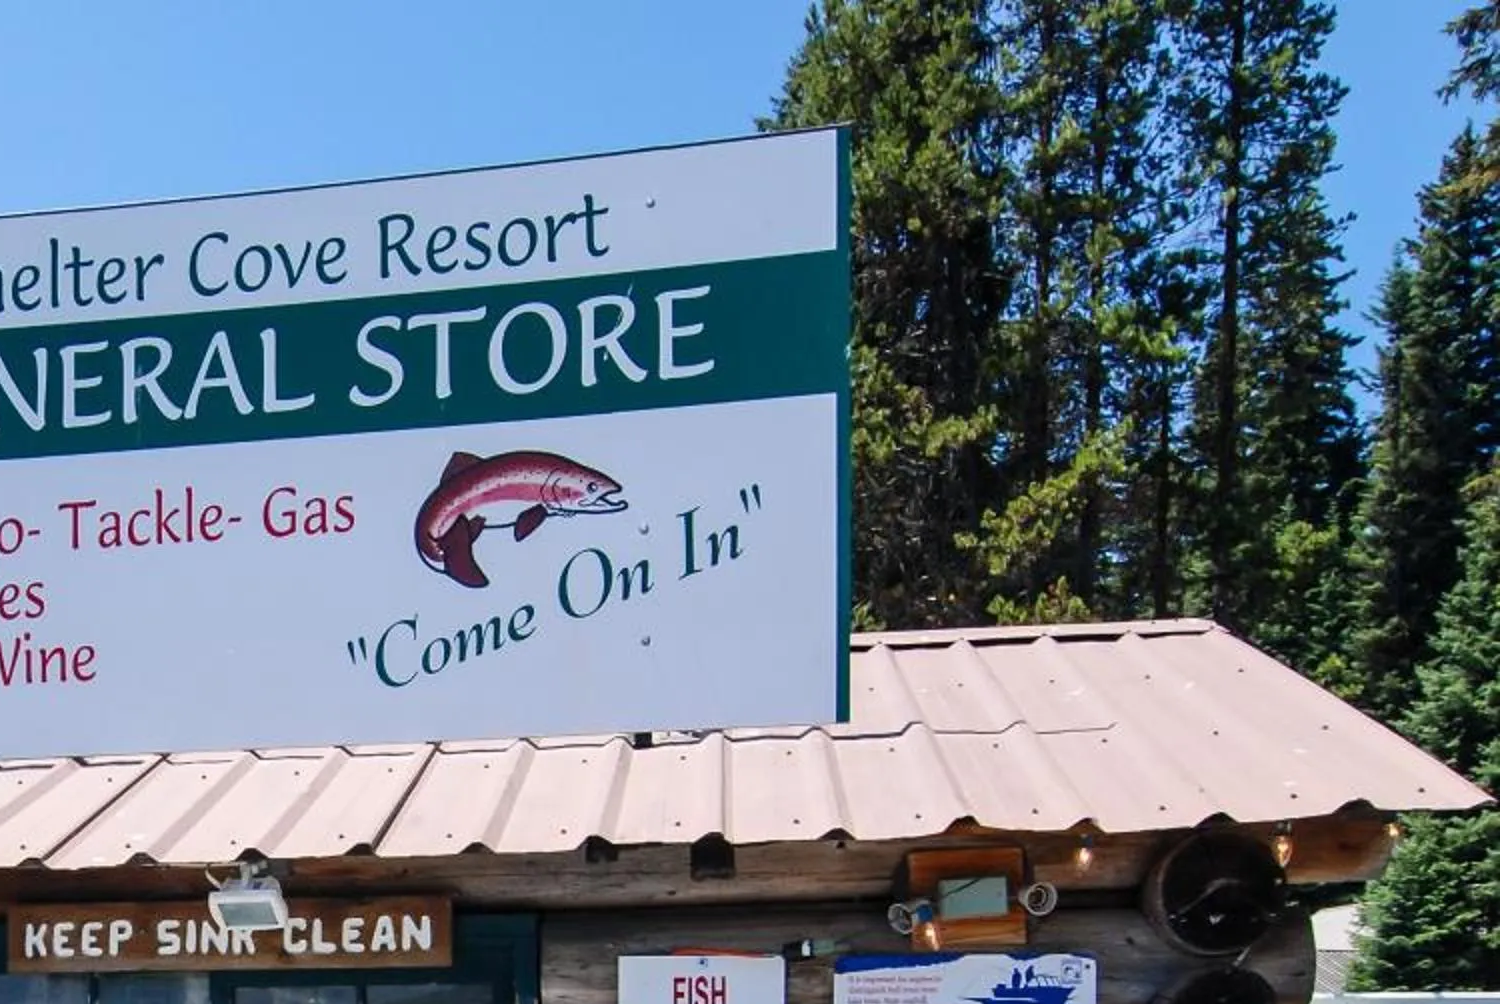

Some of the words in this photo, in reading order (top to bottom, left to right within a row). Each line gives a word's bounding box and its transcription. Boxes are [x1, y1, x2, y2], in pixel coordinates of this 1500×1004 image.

[190, 232, 347, 296] Cove
[379, 194, 609, 278] Resort
[348, 284, 715, 405] STORE
[263, 487, 354, 537] Gas
[348, 605, 535, 687] "Come
[559, 549, 654, 618] On
[677, 484, 760, 579] In"
[24, 919, 133, 958] KEEP
[157, 918, 256, 956] SINK
[283, 915, 433, 954] CLEAN
